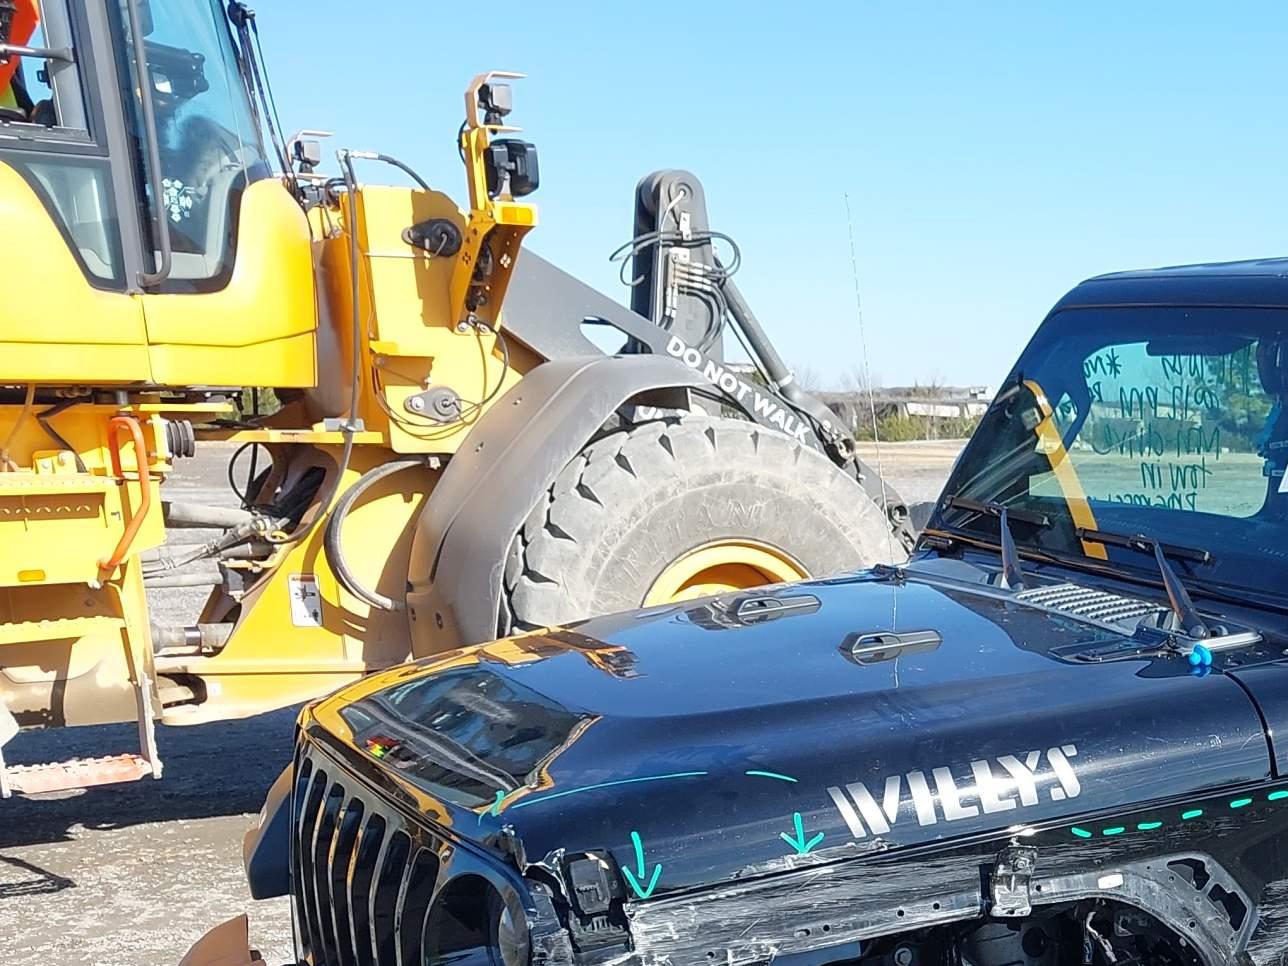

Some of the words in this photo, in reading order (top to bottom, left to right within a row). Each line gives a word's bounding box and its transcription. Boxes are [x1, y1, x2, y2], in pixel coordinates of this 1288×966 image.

[666, 335, 702, 368] DO
[703, 359, 753, 401] NOT
[752, 391, 811, 445] WALK
[826, 744, 1081, 838] WILLYS
